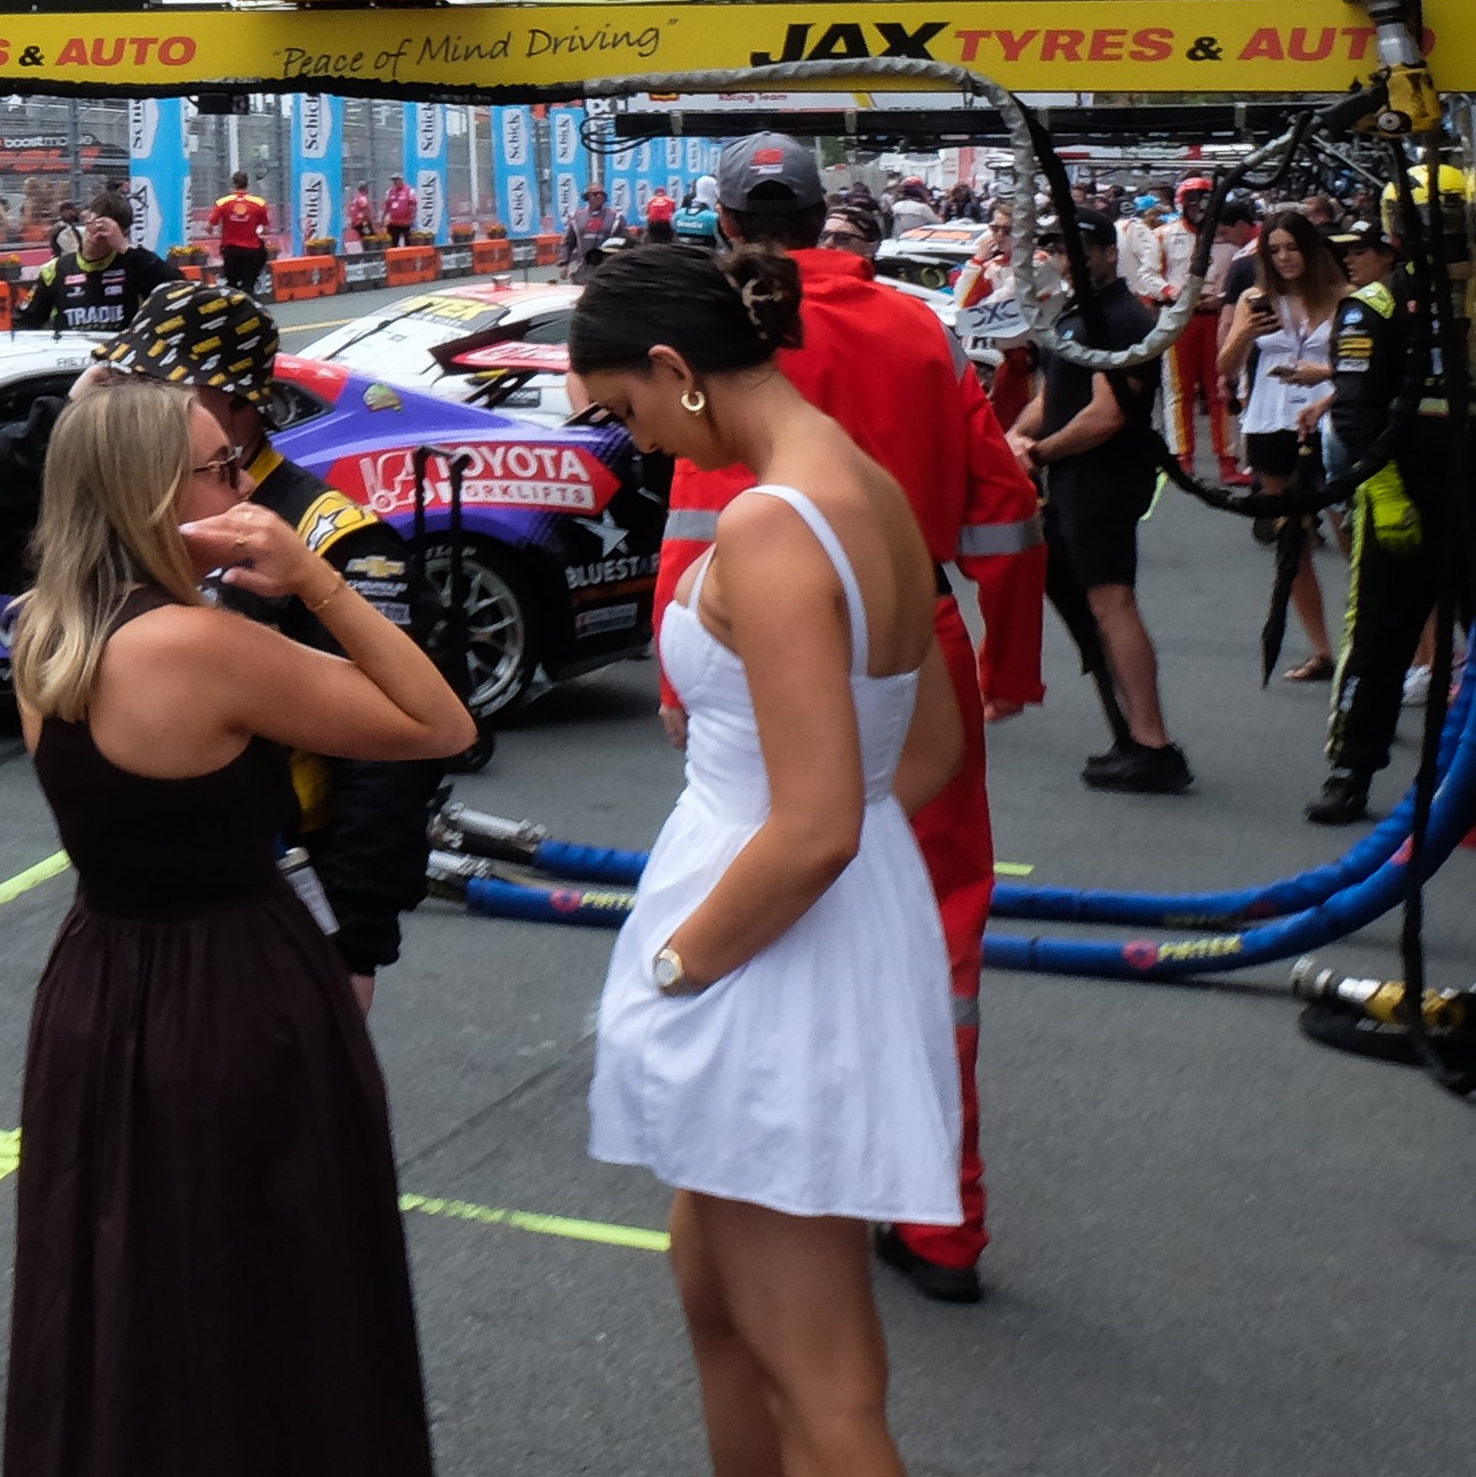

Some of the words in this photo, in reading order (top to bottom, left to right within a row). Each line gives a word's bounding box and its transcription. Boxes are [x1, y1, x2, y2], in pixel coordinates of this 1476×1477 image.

[17, 45, 46, 68] &
[54, 35, 197, 67] AUTO
[374, 38, 412, 78] of
[416, 31, 512, 67] Mind
[749, 21, 952, 65] JAX
[953, 26, 1176, 63] TYRES
[1184, 29, 1224, 63] &
